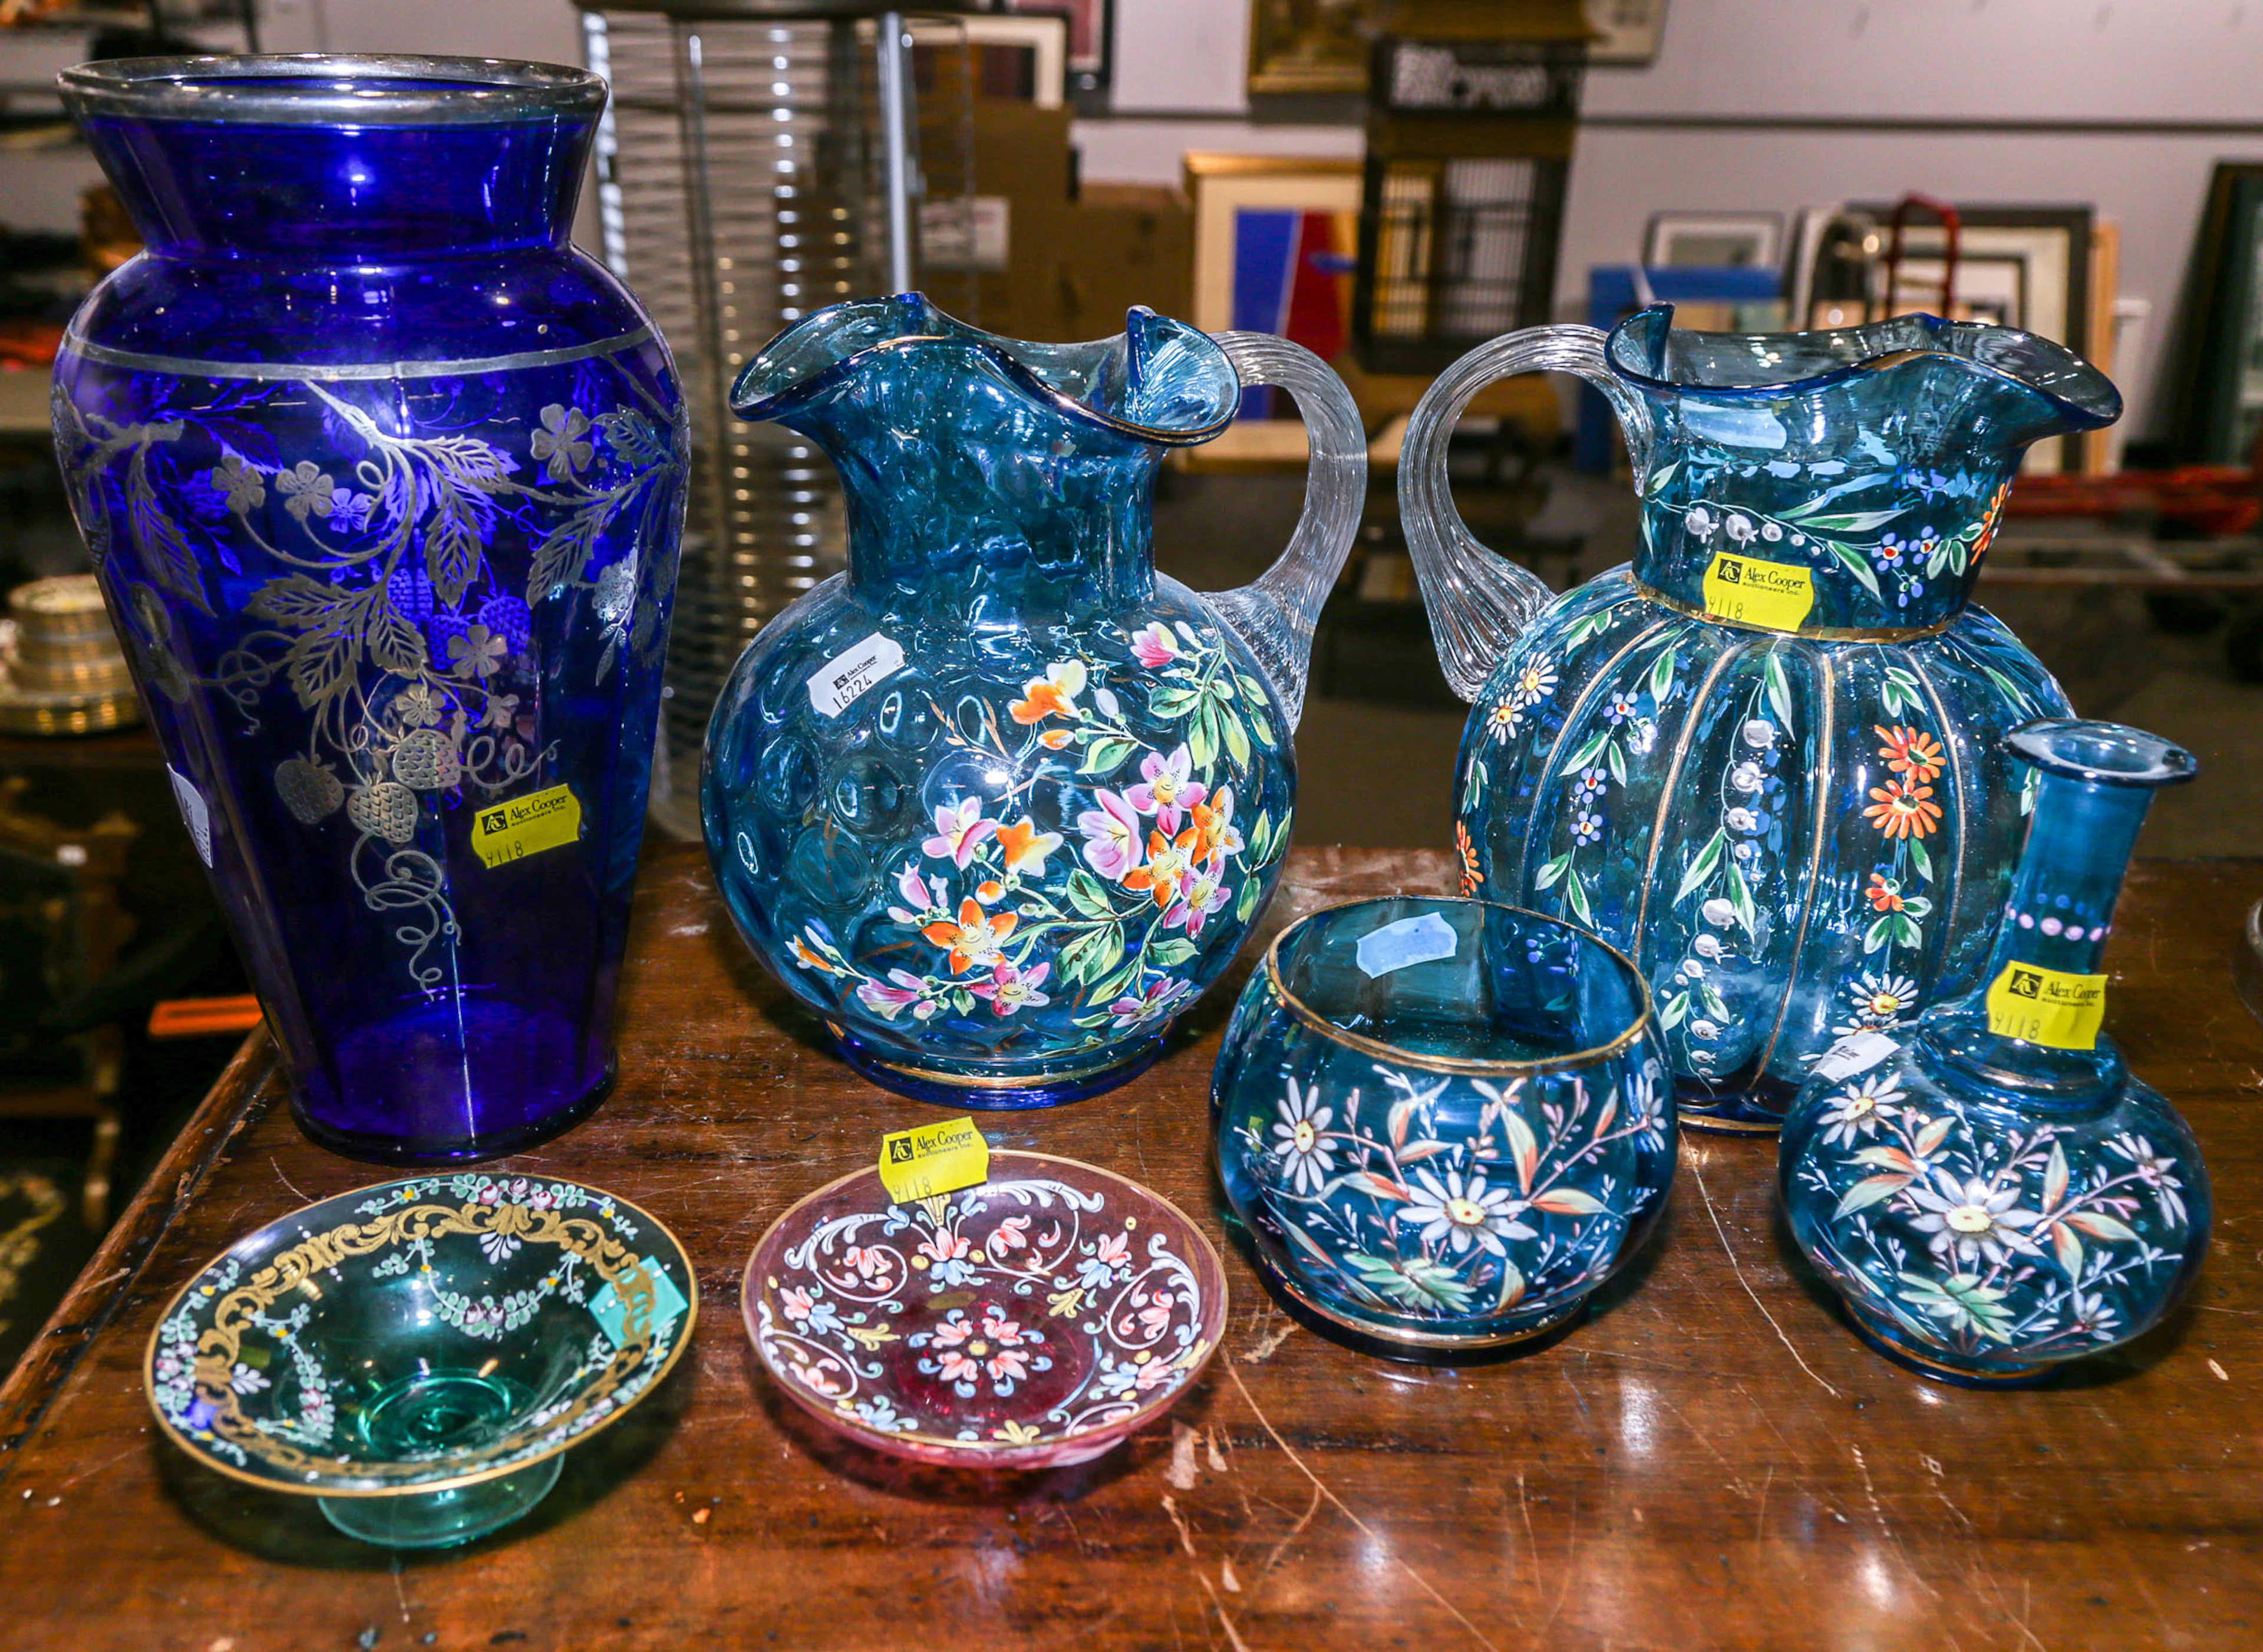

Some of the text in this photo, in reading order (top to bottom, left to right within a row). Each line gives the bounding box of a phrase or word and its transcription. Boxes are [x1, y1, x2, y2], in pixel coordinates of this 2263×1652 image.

[1743, 581, 1784, 593] auctioneers
[1744, 566, 1806, 590] Alex Cooper
[847, 667, 860, 678] Alex
[857, 655, 876, 670] Cooper
[832, 674, 873, 710] 16224
[510, 794, 568, 821] Alex Cooper
[2043, 981, 2071, 998] Alex
[916, 1130, 974, 1150] Alex Cooper
